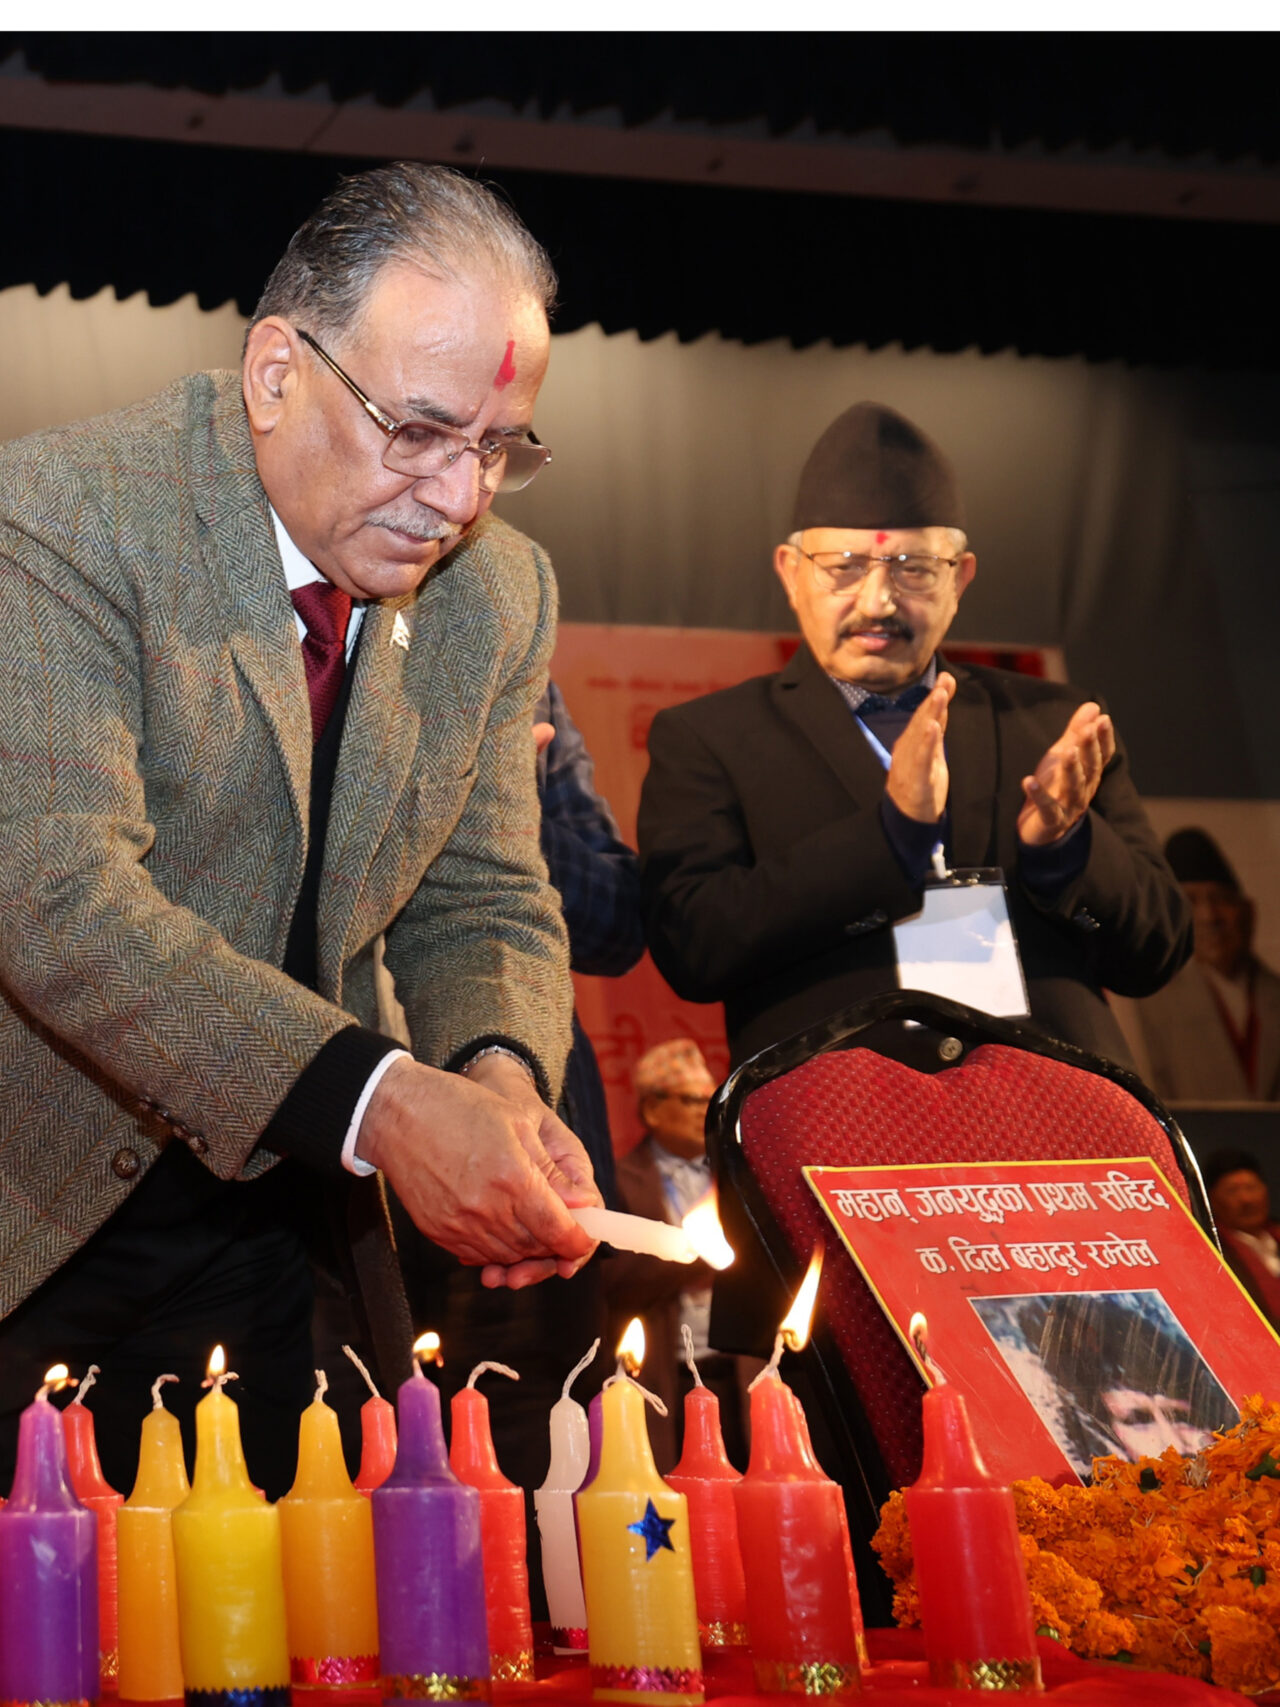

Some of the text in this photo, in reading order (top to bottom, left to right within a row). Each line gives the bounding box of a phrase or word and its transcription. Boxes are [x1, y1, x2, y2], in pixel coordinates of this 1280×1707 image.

[829, 1169, 1170, 1225] महान् जनयुद्धका प्रथम सहिद
[915, 1231, 1161, 1276] क. दिल बहादुर रम्तेल
